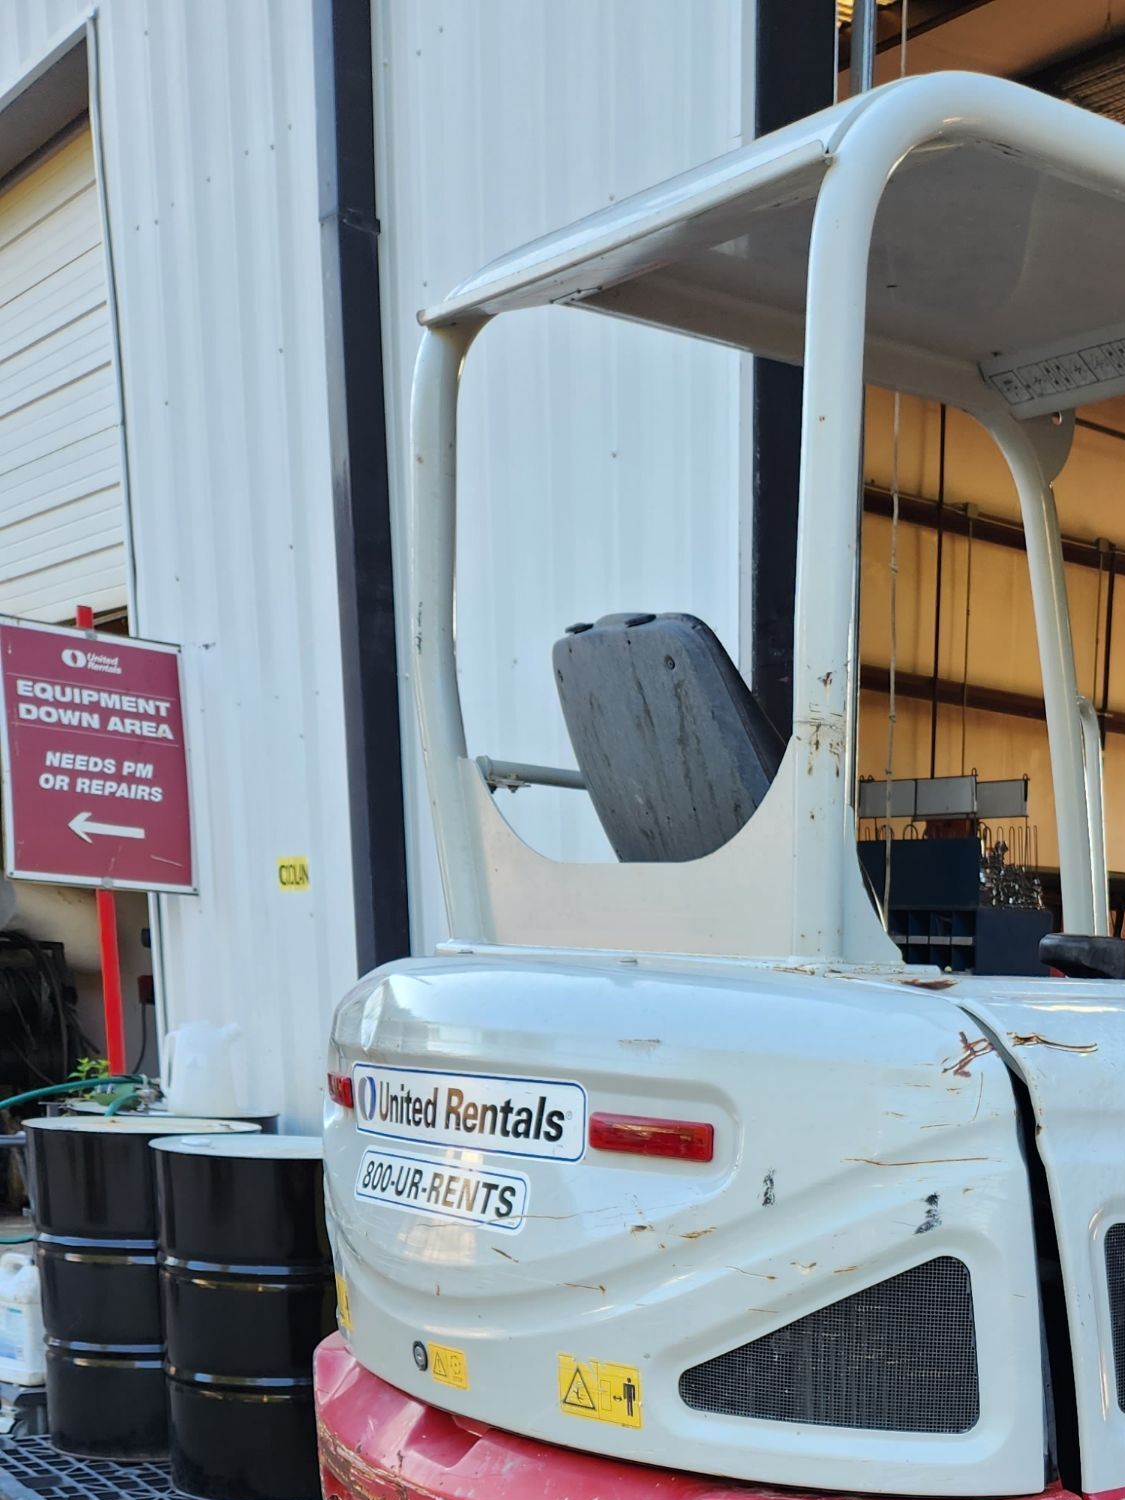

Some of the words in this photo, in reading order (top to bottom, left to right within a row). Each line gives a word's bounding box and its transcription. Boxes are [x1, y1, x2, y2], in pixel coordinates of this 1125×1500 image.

[87, 652, 119, 667] United
[87, 660, 122, 675] Rentals
[16, 679, 171, 717] EQUIPMENT
[18, 702, 100, 729] DOWN
[107, 716, 174, 740] AREA
[45, 751, 116, 775] NEEDS
[122, 761, 154, 779] PM
[39, 772, 70, 791] OR
[76, 777, 163, 803] REPAIRS
[379, 1080, 439, 1130] United
[362, 1160, 517, 1218] 800-UR-RENTS
